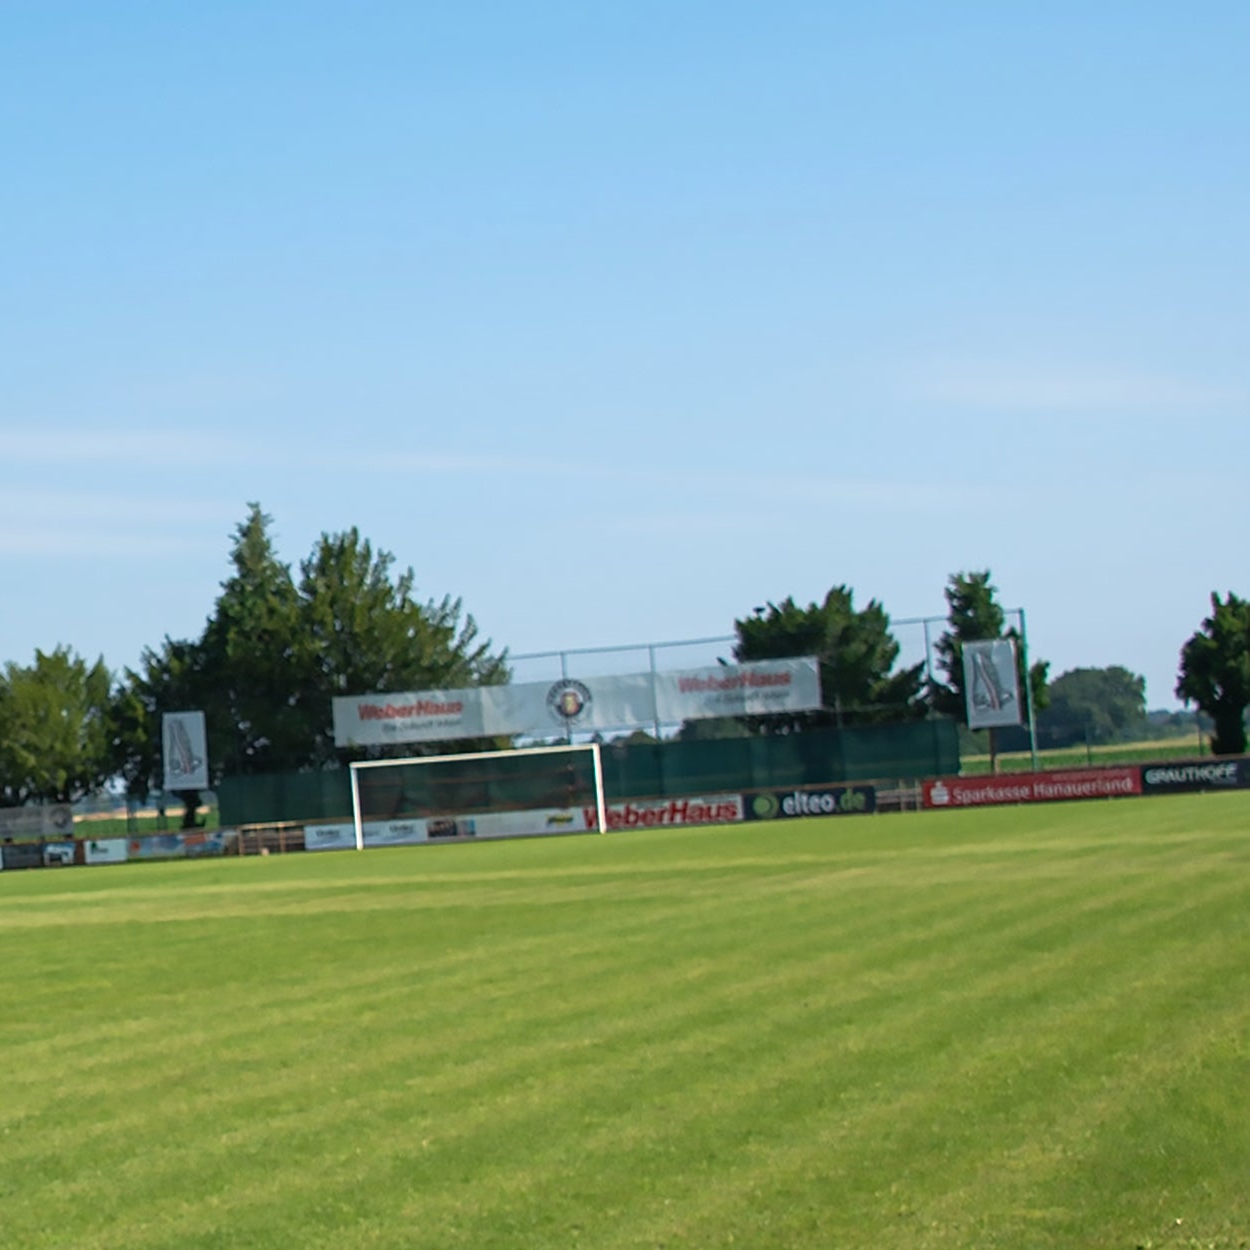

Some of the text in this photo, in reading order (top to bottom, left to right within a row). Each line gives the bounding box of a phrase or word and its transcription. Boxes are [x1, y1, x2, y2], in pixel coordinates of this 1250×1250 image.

[357, 699, 463, 721] WeberHaus
[782, 787, 866, 815] elteo.de
[952, 776, 1133, 805] Sparkasse Hanauerland
[583, 801, 738, 829] WeberHaus
